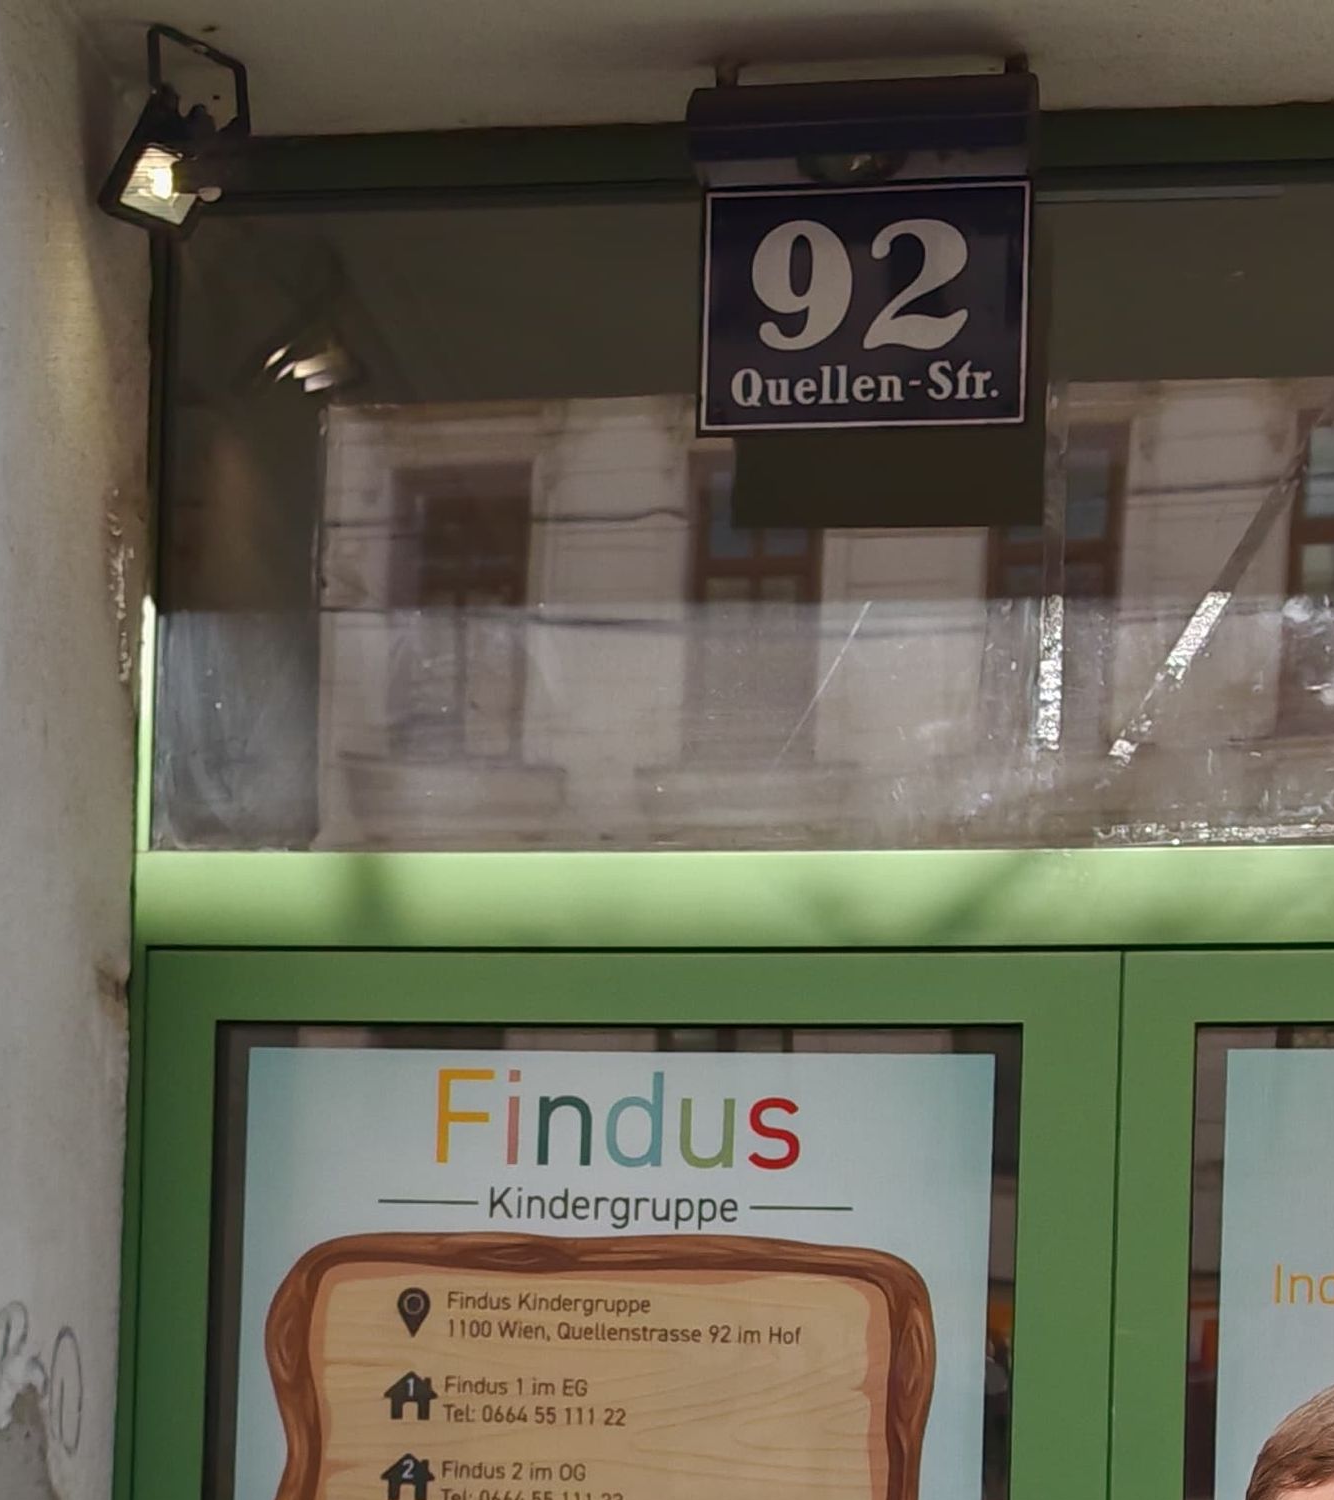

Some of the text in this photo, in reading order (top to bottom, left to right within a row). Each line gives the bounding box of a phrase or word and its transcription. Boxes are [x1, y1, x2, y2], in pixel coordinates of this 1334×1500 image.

[752, 219, 968, 351] 92
[731, 361, 999, 407] Quellen-Str.
[436, 1069, 800, 1169] Findus
[488, 1186, 738, 1229] Kindergruppe
[447, 1291, 651, 1316] Findus Kindergruppe
[447, 1320, 802, 1345] 1100 Wien, Quellenstrasse 92 im Hof
[406, 1378, 415, 1396] 1
[444, 1376, 588, 1397] Findus 1 im EG
[443, 1405, 626, 1427] Tel: 0664 55 111 22
[401, 1461, 415, 1479] 2
[441, 1461, 586, 1482] Findus 2 im OG
